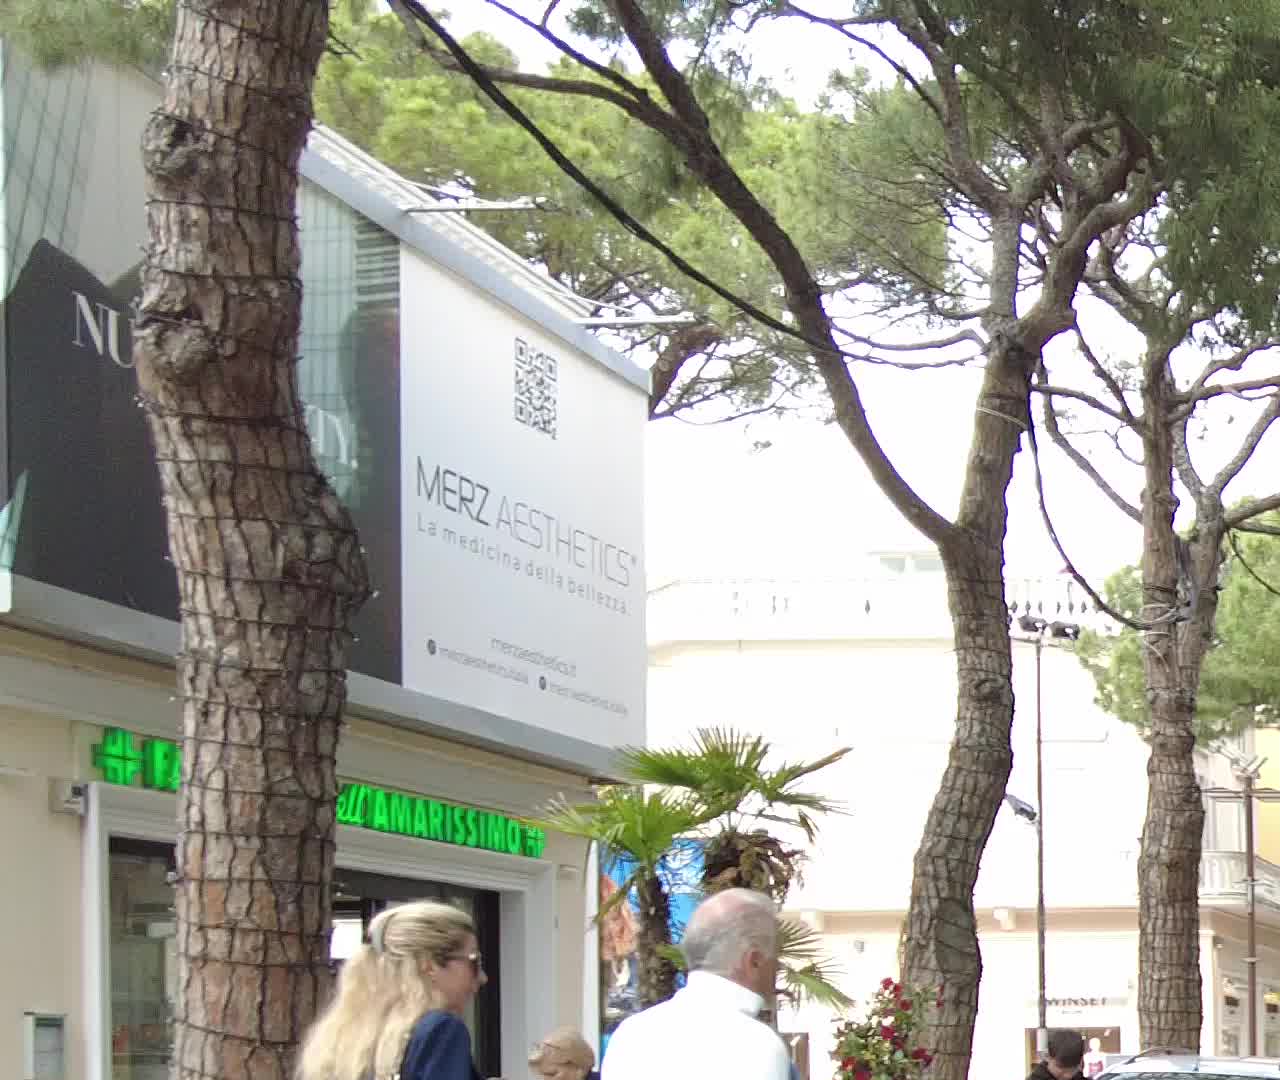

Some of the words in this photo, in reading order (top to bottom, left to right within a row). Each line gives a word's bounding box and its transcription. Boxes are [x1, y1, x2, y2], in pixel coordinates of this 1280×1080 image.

[416, 455, 491, 527] MERZ
[417, 512, 437, 537] La
[443, 527, 521, 572] medicina
[525, 559, 564, 589] della
[1042, 996, 1107, 1008] WINSET
